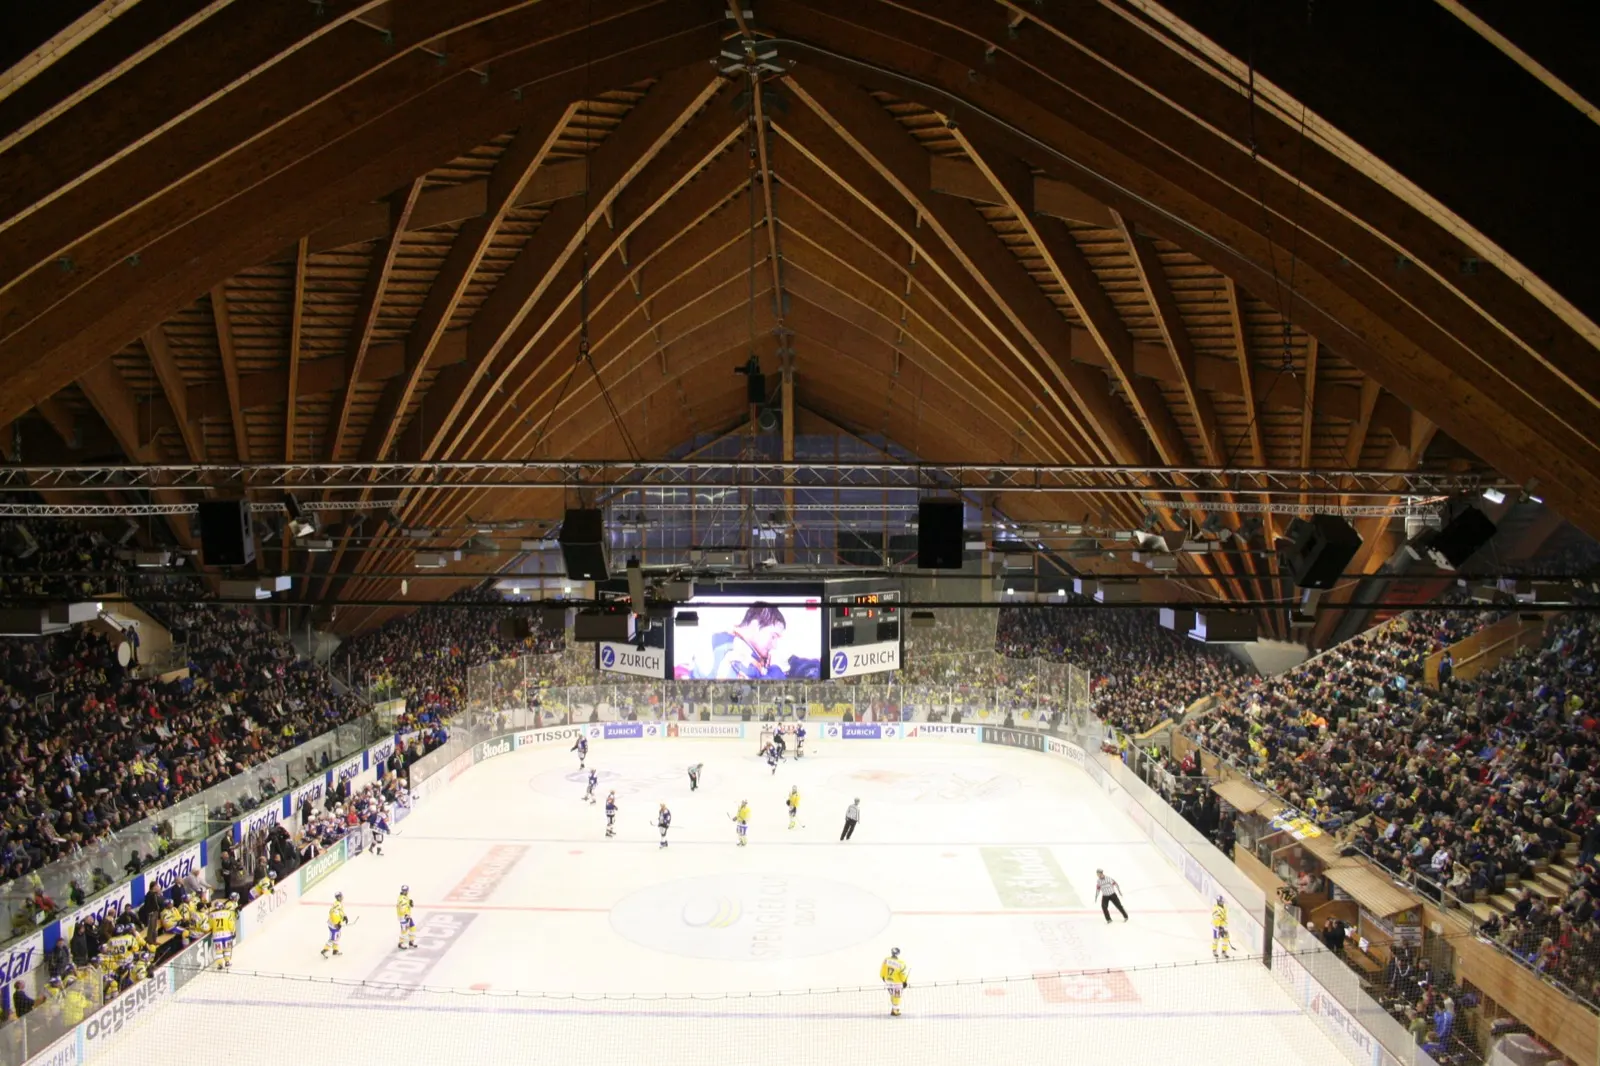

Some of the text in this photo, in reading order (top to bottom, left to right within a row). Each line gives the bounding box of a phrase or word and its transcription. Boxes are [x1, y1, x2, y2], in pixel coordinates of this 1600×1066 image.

[620, 653, 660, 670] ZURICH
[853, 650, 895, 668] ZURICH
[535, 729, 580, 743] TISSOT
[608, 728, 637, 736] ZURICH
[846, 728, 875, 736] ZURICH
[919, 725, 977, 735] sportart
[482, 739, 510, 760] Škoda
[155, 855, 195, 890] isostar
[305, 848, 340, 883] Europcar
[86, 970, 168, 1041] OCHSNER
